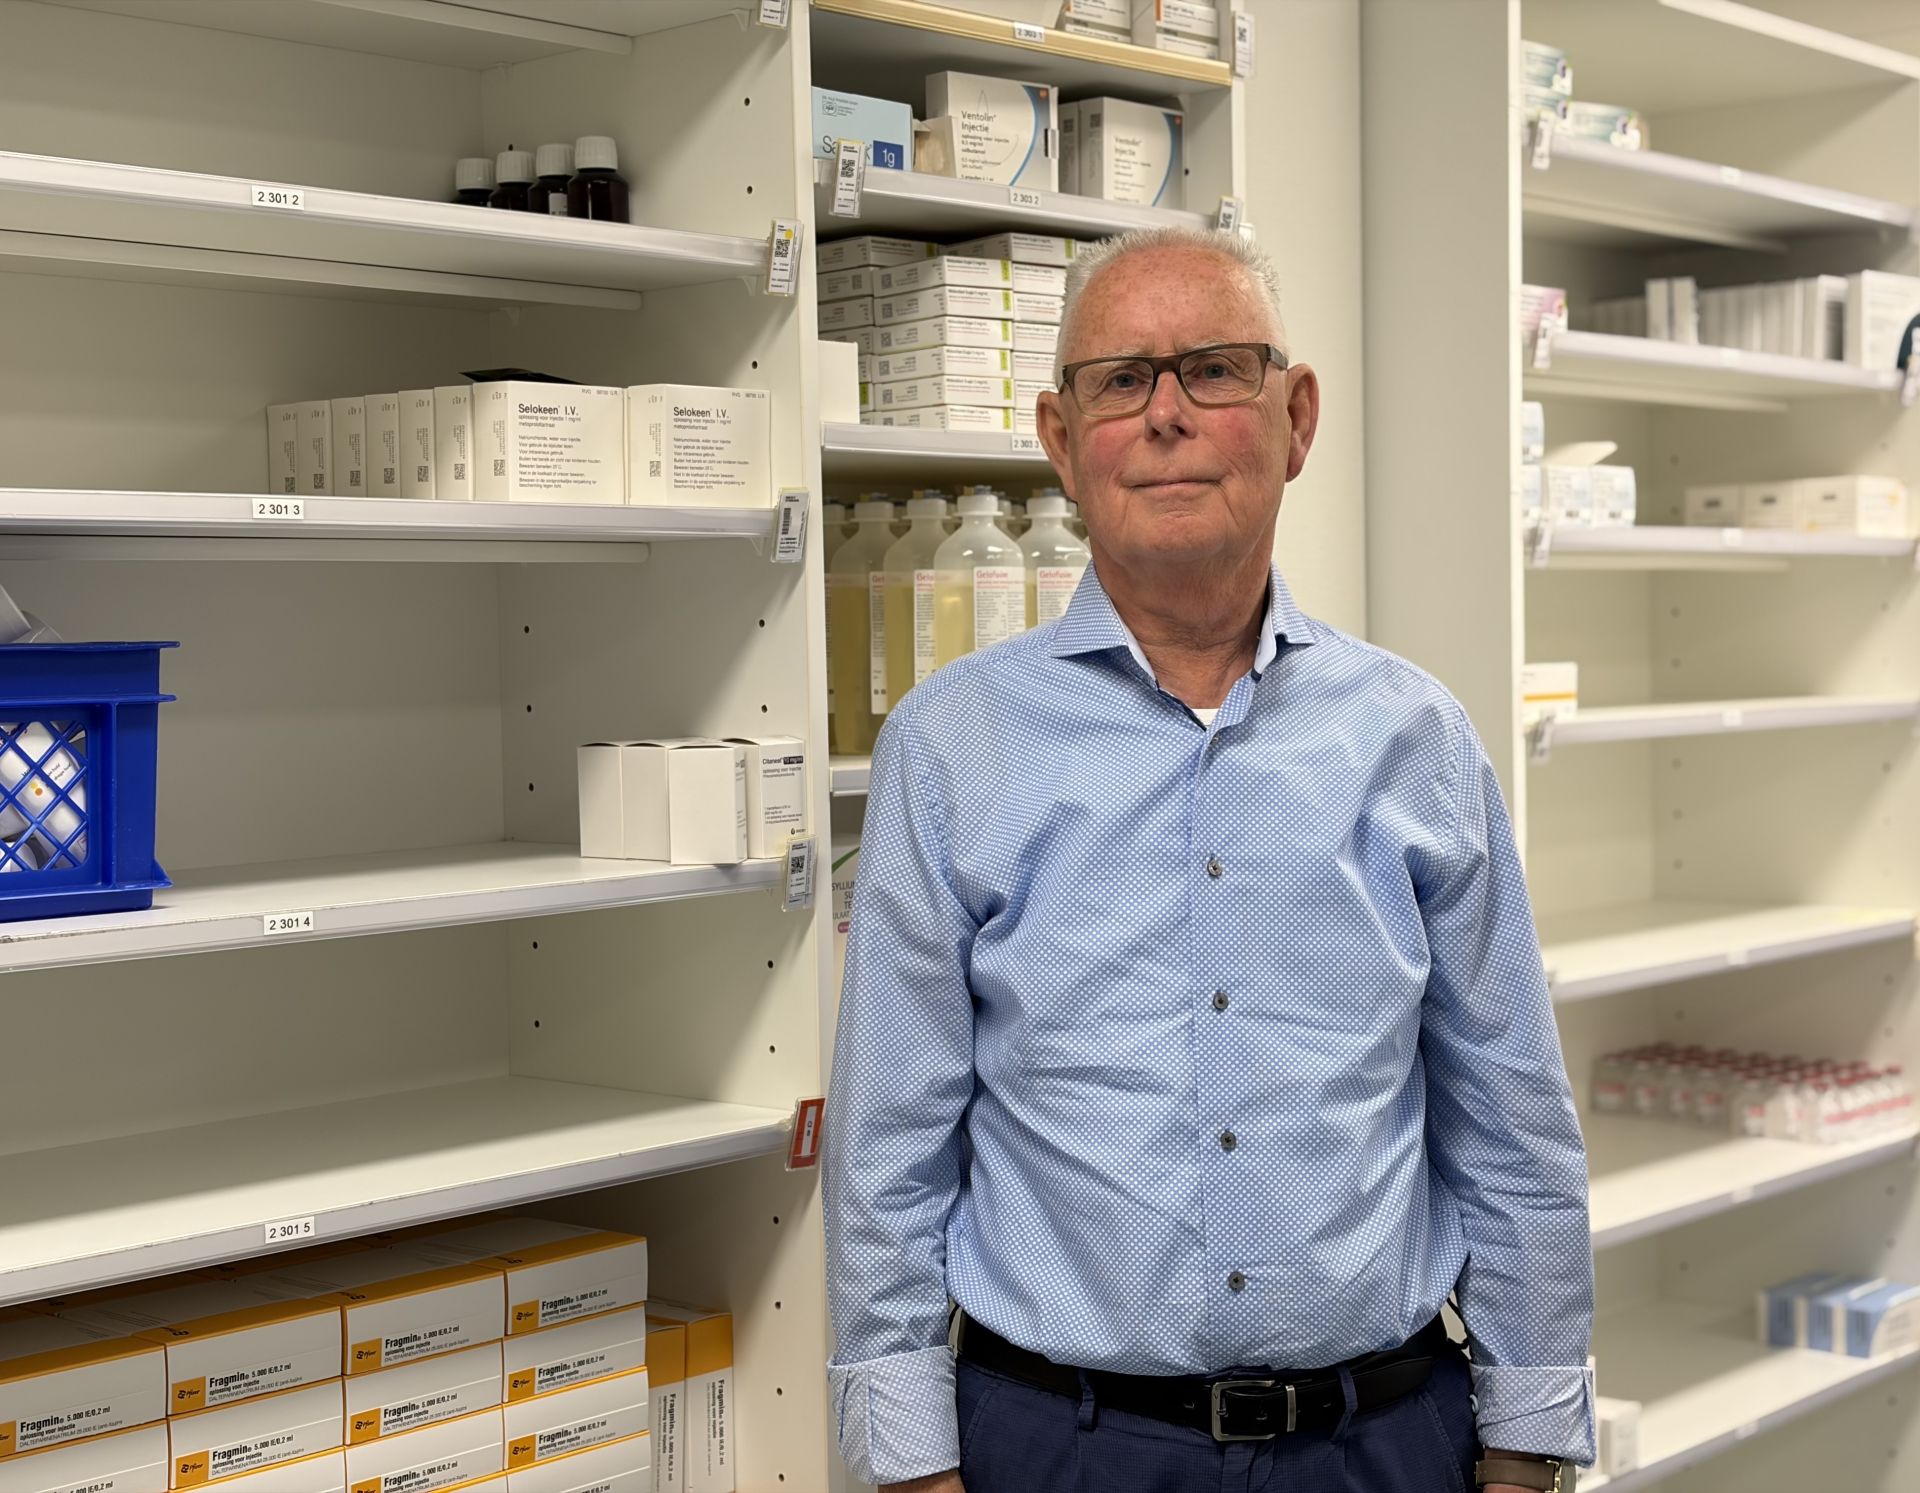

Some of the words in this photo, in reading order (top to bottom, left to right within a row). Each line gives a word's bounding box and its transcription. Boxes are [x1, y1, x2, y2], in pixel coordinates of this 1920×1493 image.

[961, 122, 989, 132] Injectie
[882, 149, 895, 167] 1g
[258, 192, 264, 202] 2
[269, 192, 287, 204] 301
[292, 195, 299, 205] 2
[1013, 193, 1018, 201] 2
[1020, 194, 1033, 203] 303
[1034, 196, 1039, 204] 2
[518, 403, 558, 414] Selokeen
[565, 406, 579, 415] I.V.
[673, 406, 711, 417] Selokeen
[1014, 440, 1018, 448] 2
[1021, 440, 1033, 448] 303
[259, 504, 265, 514] 2
[269, 504, 288, 514] 301
[293, 505, 299, 515] 3
[832, 880, 855, 891] SYLLIU
[270, 920, 276, 930] 2
[280, 918, 299, 929] 301
[304, 916, 310, 926] 4
[270, 1228, 276, 1238] 2
[280, 1224, 298, 1236] 301
[304, 1222, 310, 1232] 5
[424, 1328, 438, 1339] 5.000
[252, 1366, 267, 1378] 5.000
[243, 1379, 260, 1388] injectie
[422, 1397, 436, 1408] 5.000
[67, 1410, 84, 1422] 5.000
[102, 1406, 110, 1414] ml
[45, 1427, 56, 1435] voor
[574, 1423, 587, 1434] 5.000
[254, 1439, 269, 1450] 5.000
[421, 1465, 436, 1476] 5.000
